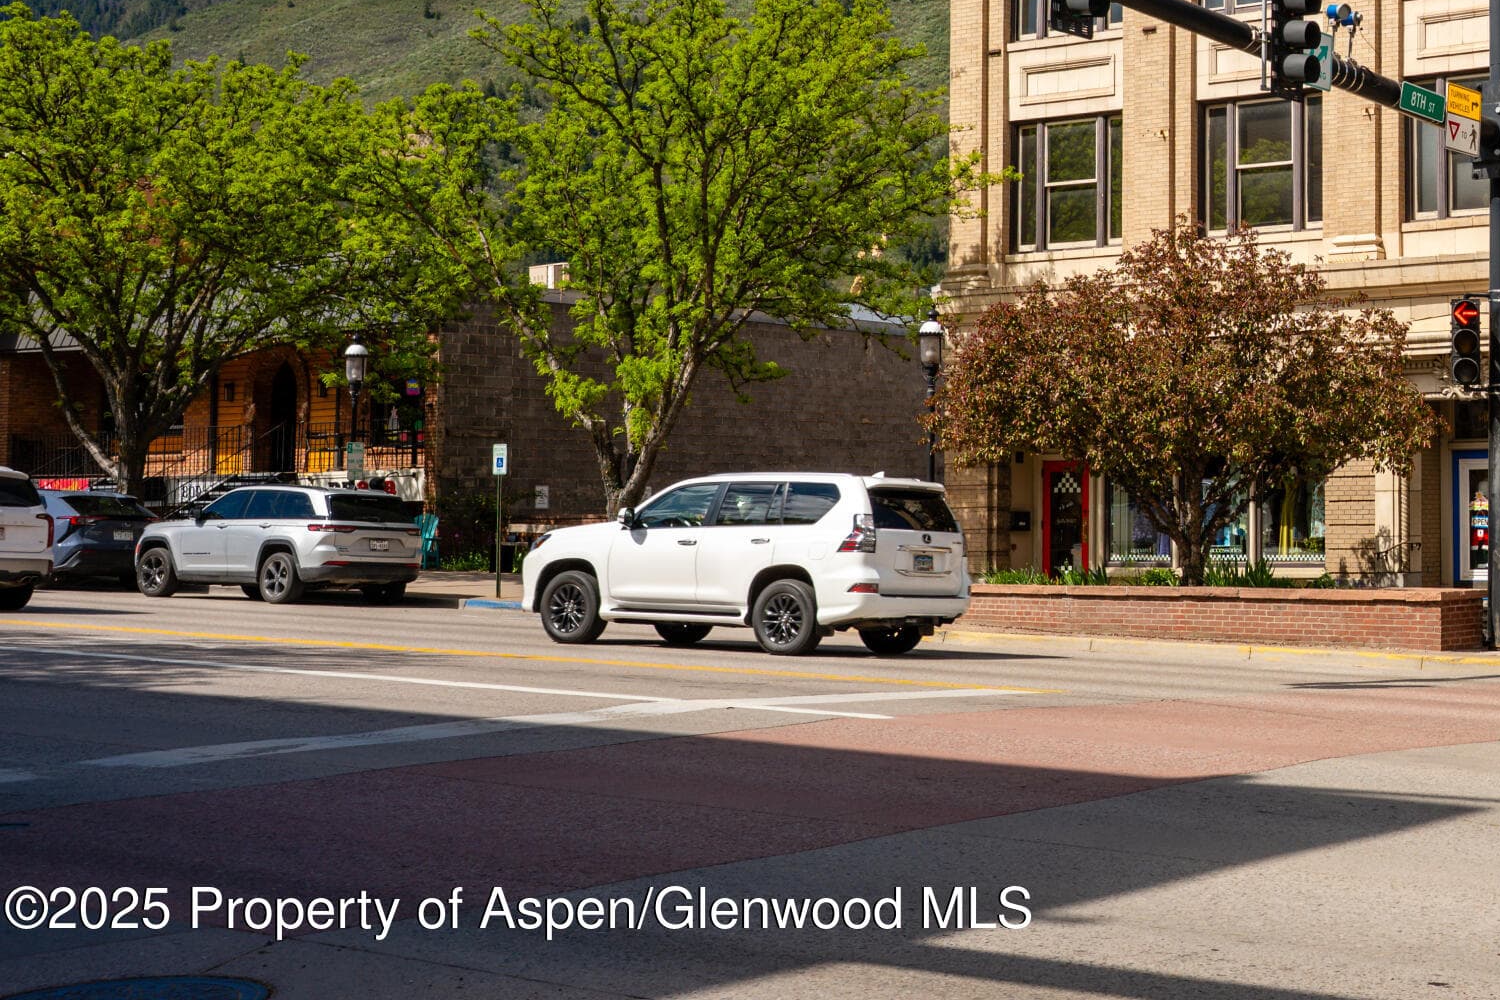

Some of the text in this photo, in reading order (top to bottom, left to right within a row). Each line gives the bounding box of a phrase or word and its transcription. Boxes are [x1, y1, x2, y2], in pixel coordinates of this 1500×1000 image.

[1410, 91, 1436, 114] 8TH ST
[1451, 89, 1470, 103] TURNING
[1450, 101, 1470, 114] VEHICLES
[1461, 130, 1468, 140] TO
